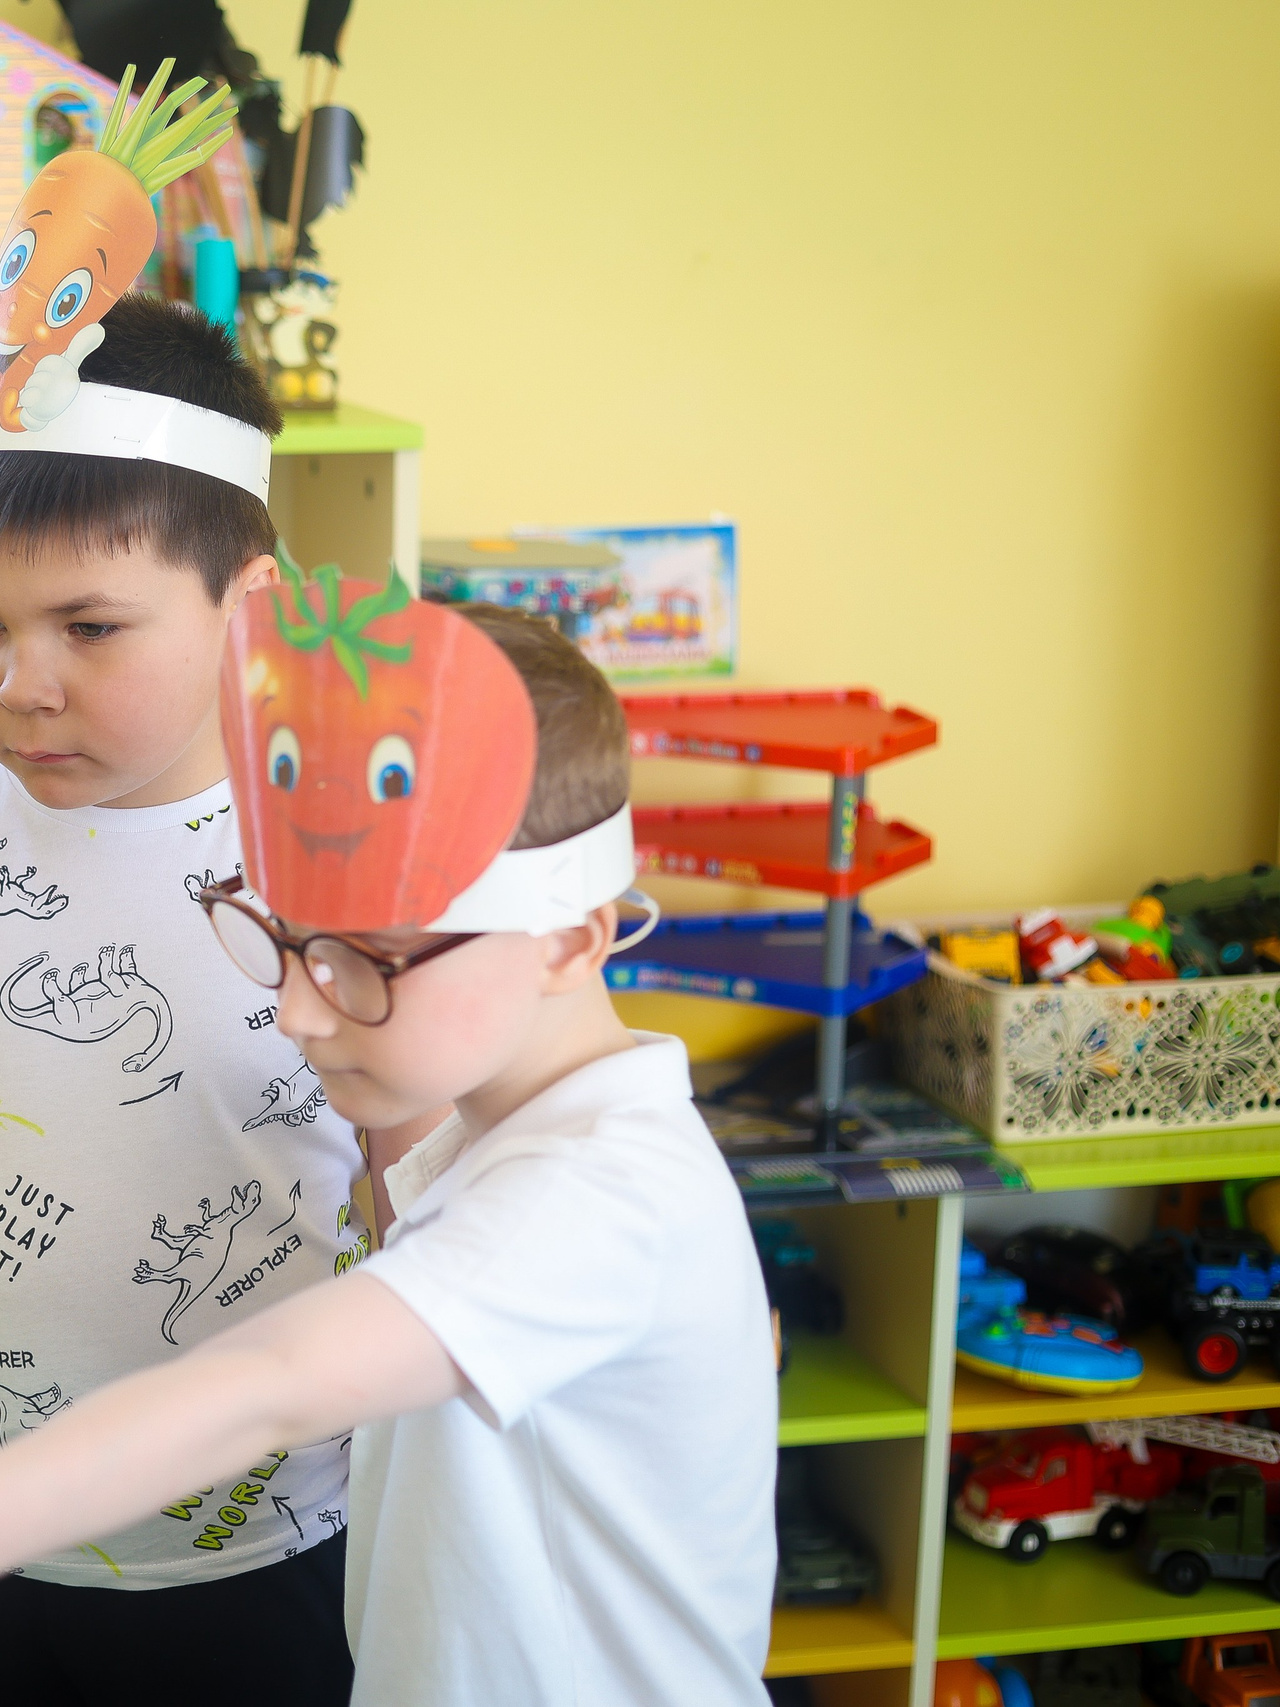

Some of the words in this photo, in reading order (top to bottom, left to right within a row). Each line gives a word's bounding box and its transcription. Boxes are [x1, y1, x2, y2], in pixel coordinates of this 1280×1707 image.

[4, 1174, 75, 1226] JUST
[214, 1233, 303, 1308] EXPLORER
[193, 1450, 289, 1550] WORL
